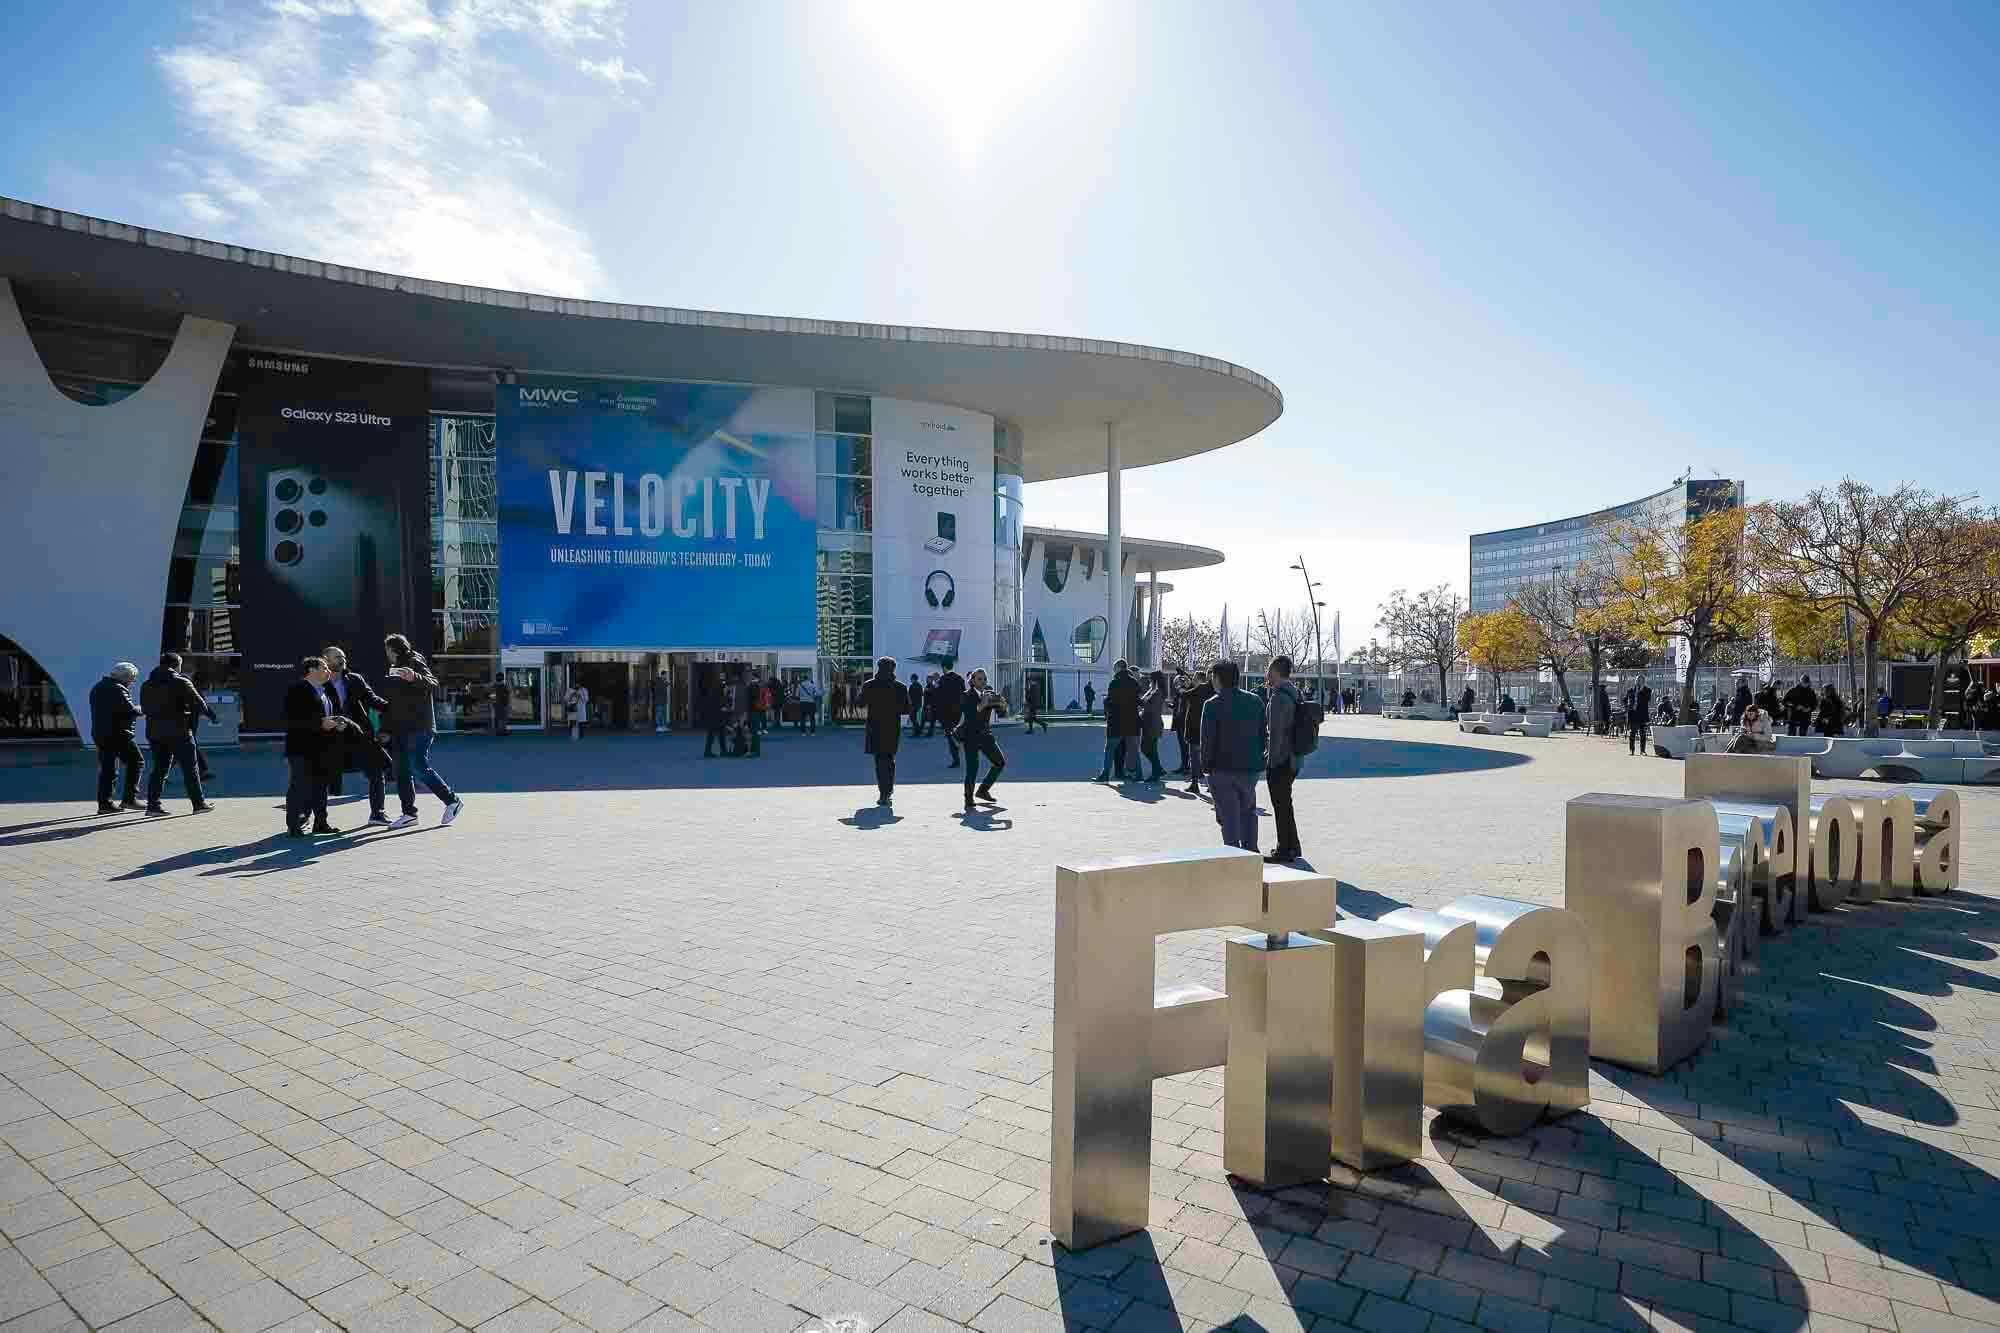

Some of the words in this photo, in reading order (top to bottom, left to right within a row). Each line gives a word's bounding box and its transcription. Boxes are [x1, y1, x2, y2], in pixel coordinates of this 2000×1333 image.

[248, 358, 309, 374] SAMSUNG
[519, 387, 578, 402] MWC
[281, 407, 332, 423] Galaxy
[335, 412, 358, 424] S23
[359, 413, 391, 426] Ultra
[906, 451, 969, 472] Everything
[901, 468, 937, 480] works
[940, 470, 974, 484] better
[912, 483, 964, 497] together
[548, 469, 771, 540] VELOCITY
[550, 548, 611, 564] UNLEASHING
[613, 550, 677, 566] TOMORROW'S
[679, 551, 737, 567] TECHNOLOGY
[744, 553, 772, 568] TODAY
[1051, 846, 1591, 1251] Fira
[1566, 752, 1960, 1075] Bcelona
